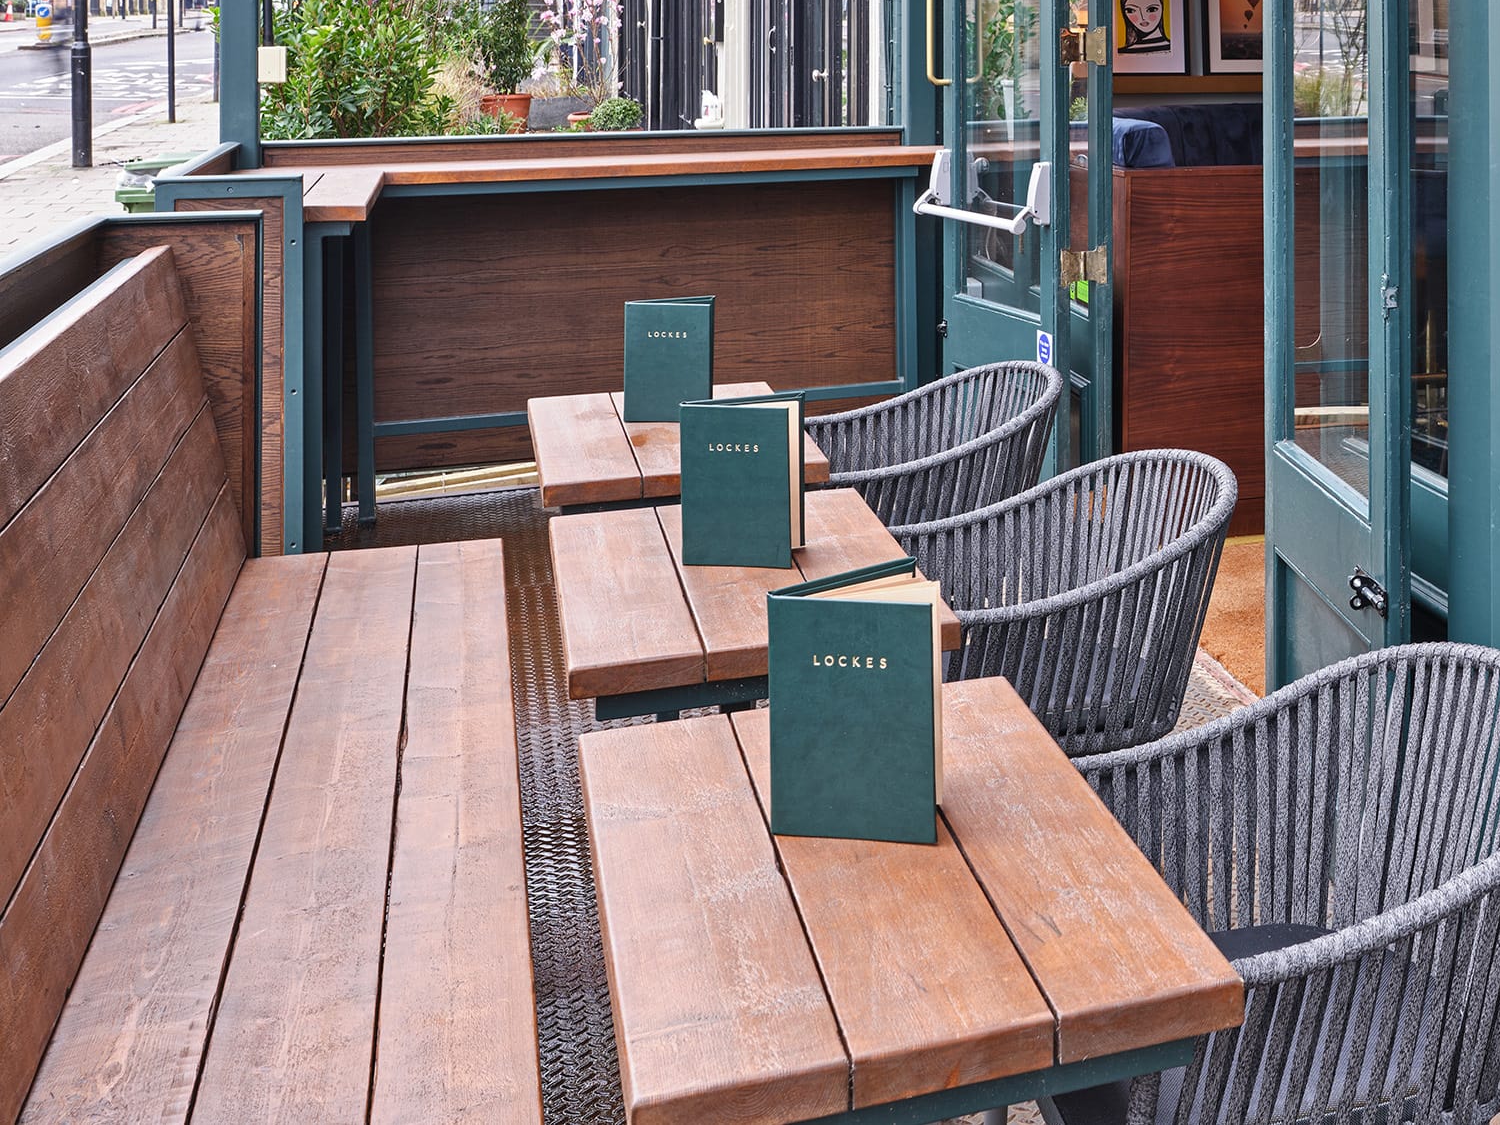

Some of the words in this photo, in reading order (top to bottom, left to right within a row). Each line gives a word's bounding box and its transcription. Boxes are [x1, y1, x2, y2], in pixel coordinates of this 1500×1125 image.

[647, 331, 687, 339] LOCKES
[709, 443, 760, 453] LOCKES
[813, 654, 888, 670] LOCKES
